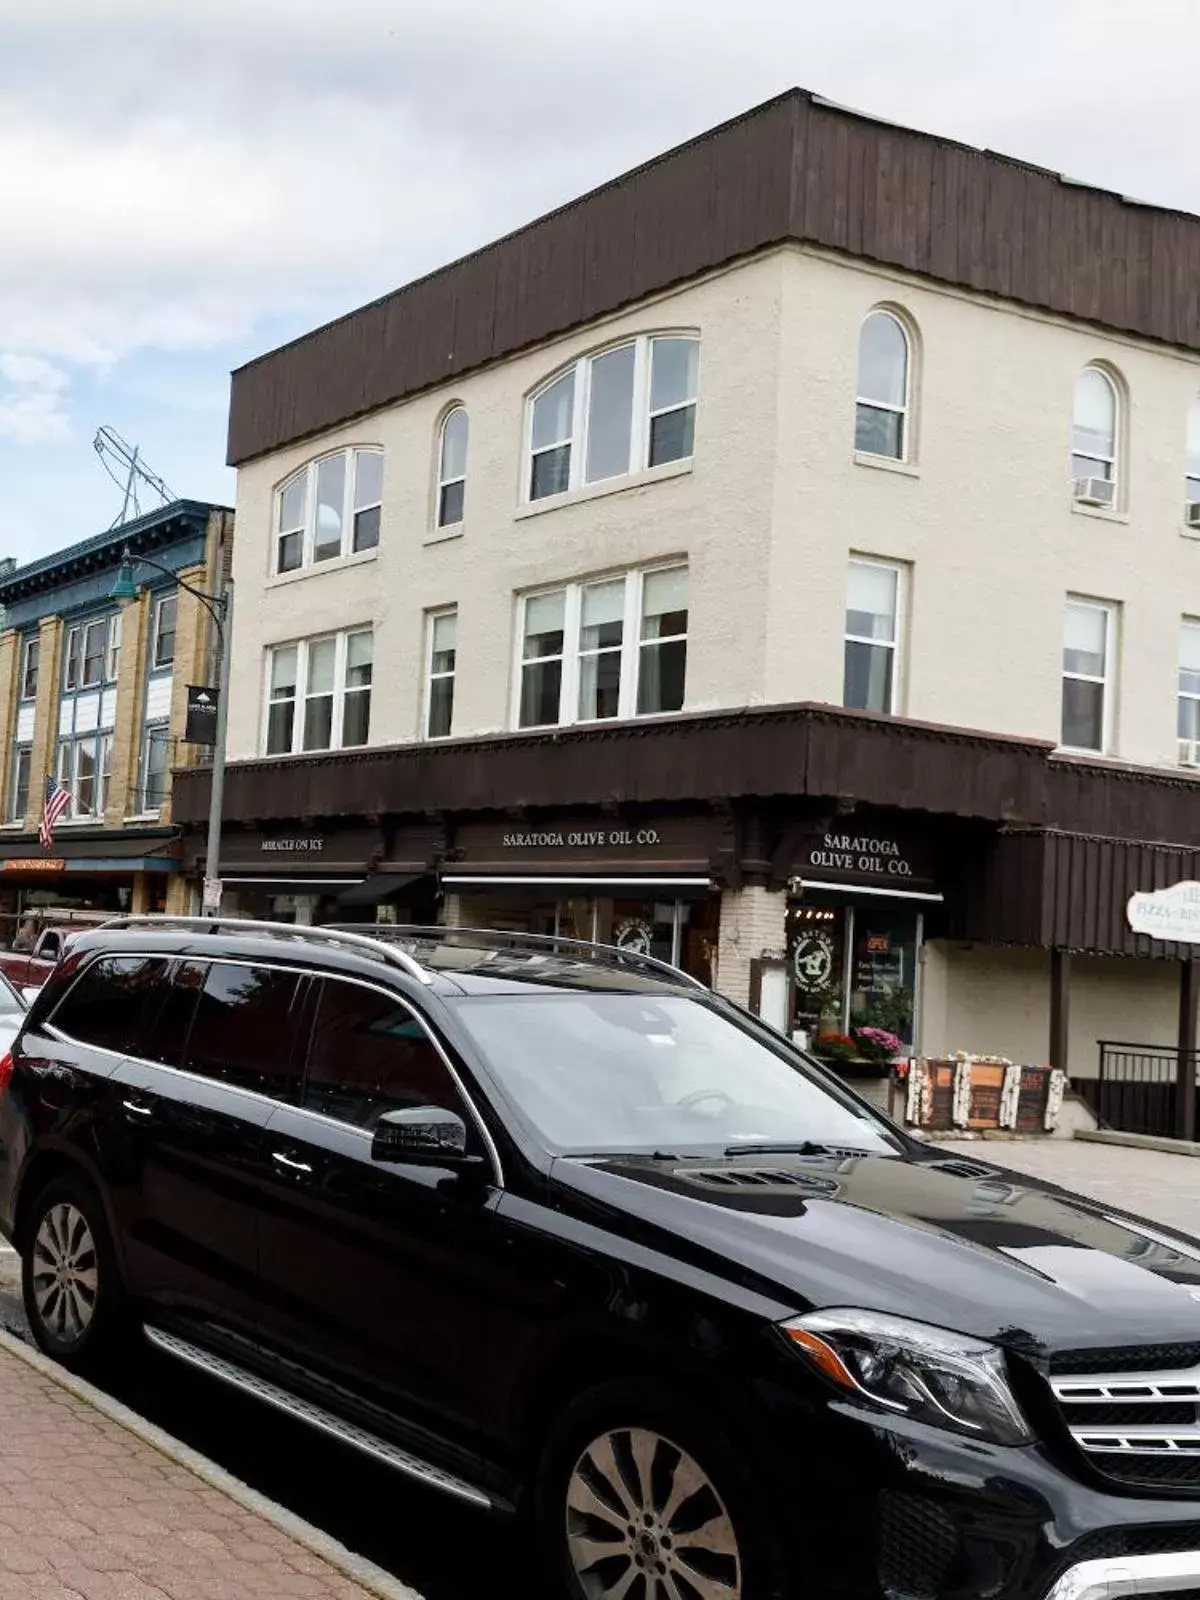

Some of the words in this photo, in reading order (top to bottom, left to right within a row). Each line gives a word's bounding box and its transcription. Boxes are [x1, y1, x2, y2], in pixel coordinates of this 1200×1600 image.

[309, 839, 324, 851] ICE
[502, 832, 564, 847] SARATOGA
[567, 831, 606, 846] OLIVE
[609, 831, 633, 845] OIL
[636, 829, 661, 845] CO.
[823, 832, 900, 856] SARATOGA
[810, 850, 854, 869] OLIVE
[858, 856, 884, 872] OIL
[887, 860, 913, 876] CO.
